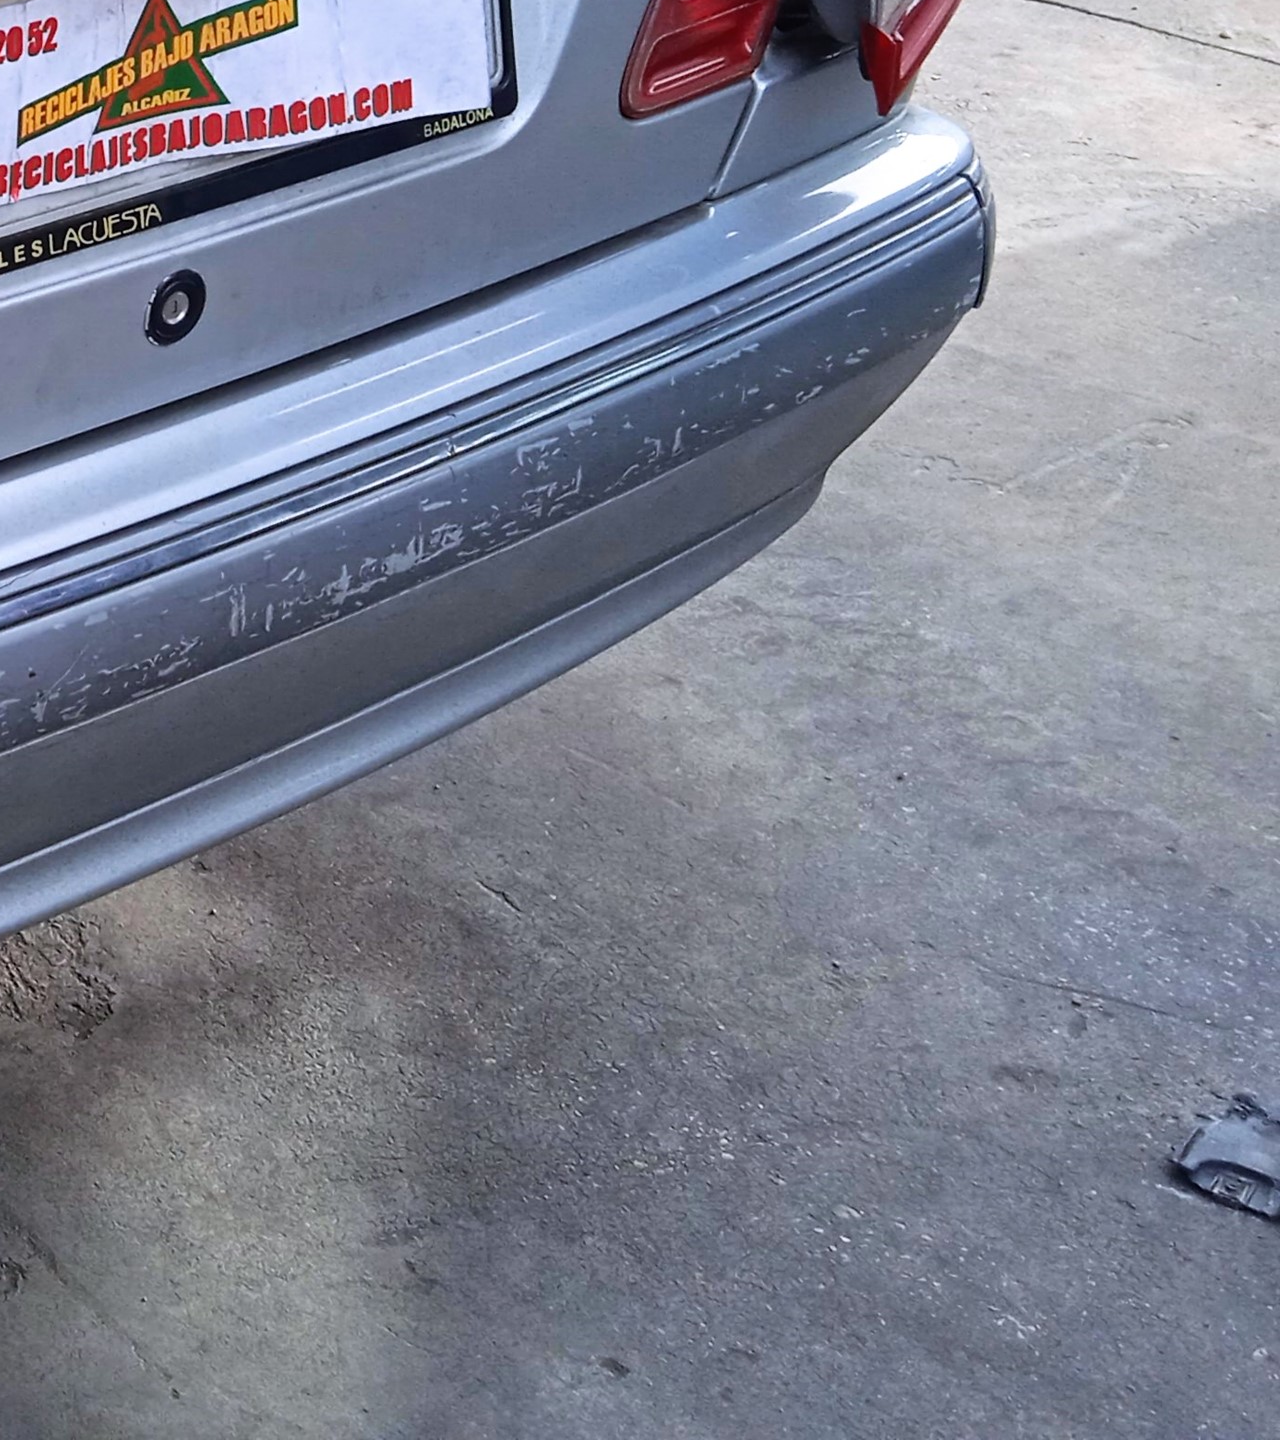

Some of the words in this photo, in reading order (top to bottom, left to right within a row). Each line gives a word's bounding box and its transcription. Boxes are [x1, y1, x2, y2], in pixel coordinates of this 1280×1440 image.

[28, 17, 58, 58] 52
[21, 57, 136, 139] RECICLAJES
[140, 31, 195, 81] BAJO
[121, 86, 191, 117] ALCAÑIZ
[47, 203, 163, 256] LACUESTA
[423, 106, 494, 138] BADALONA
